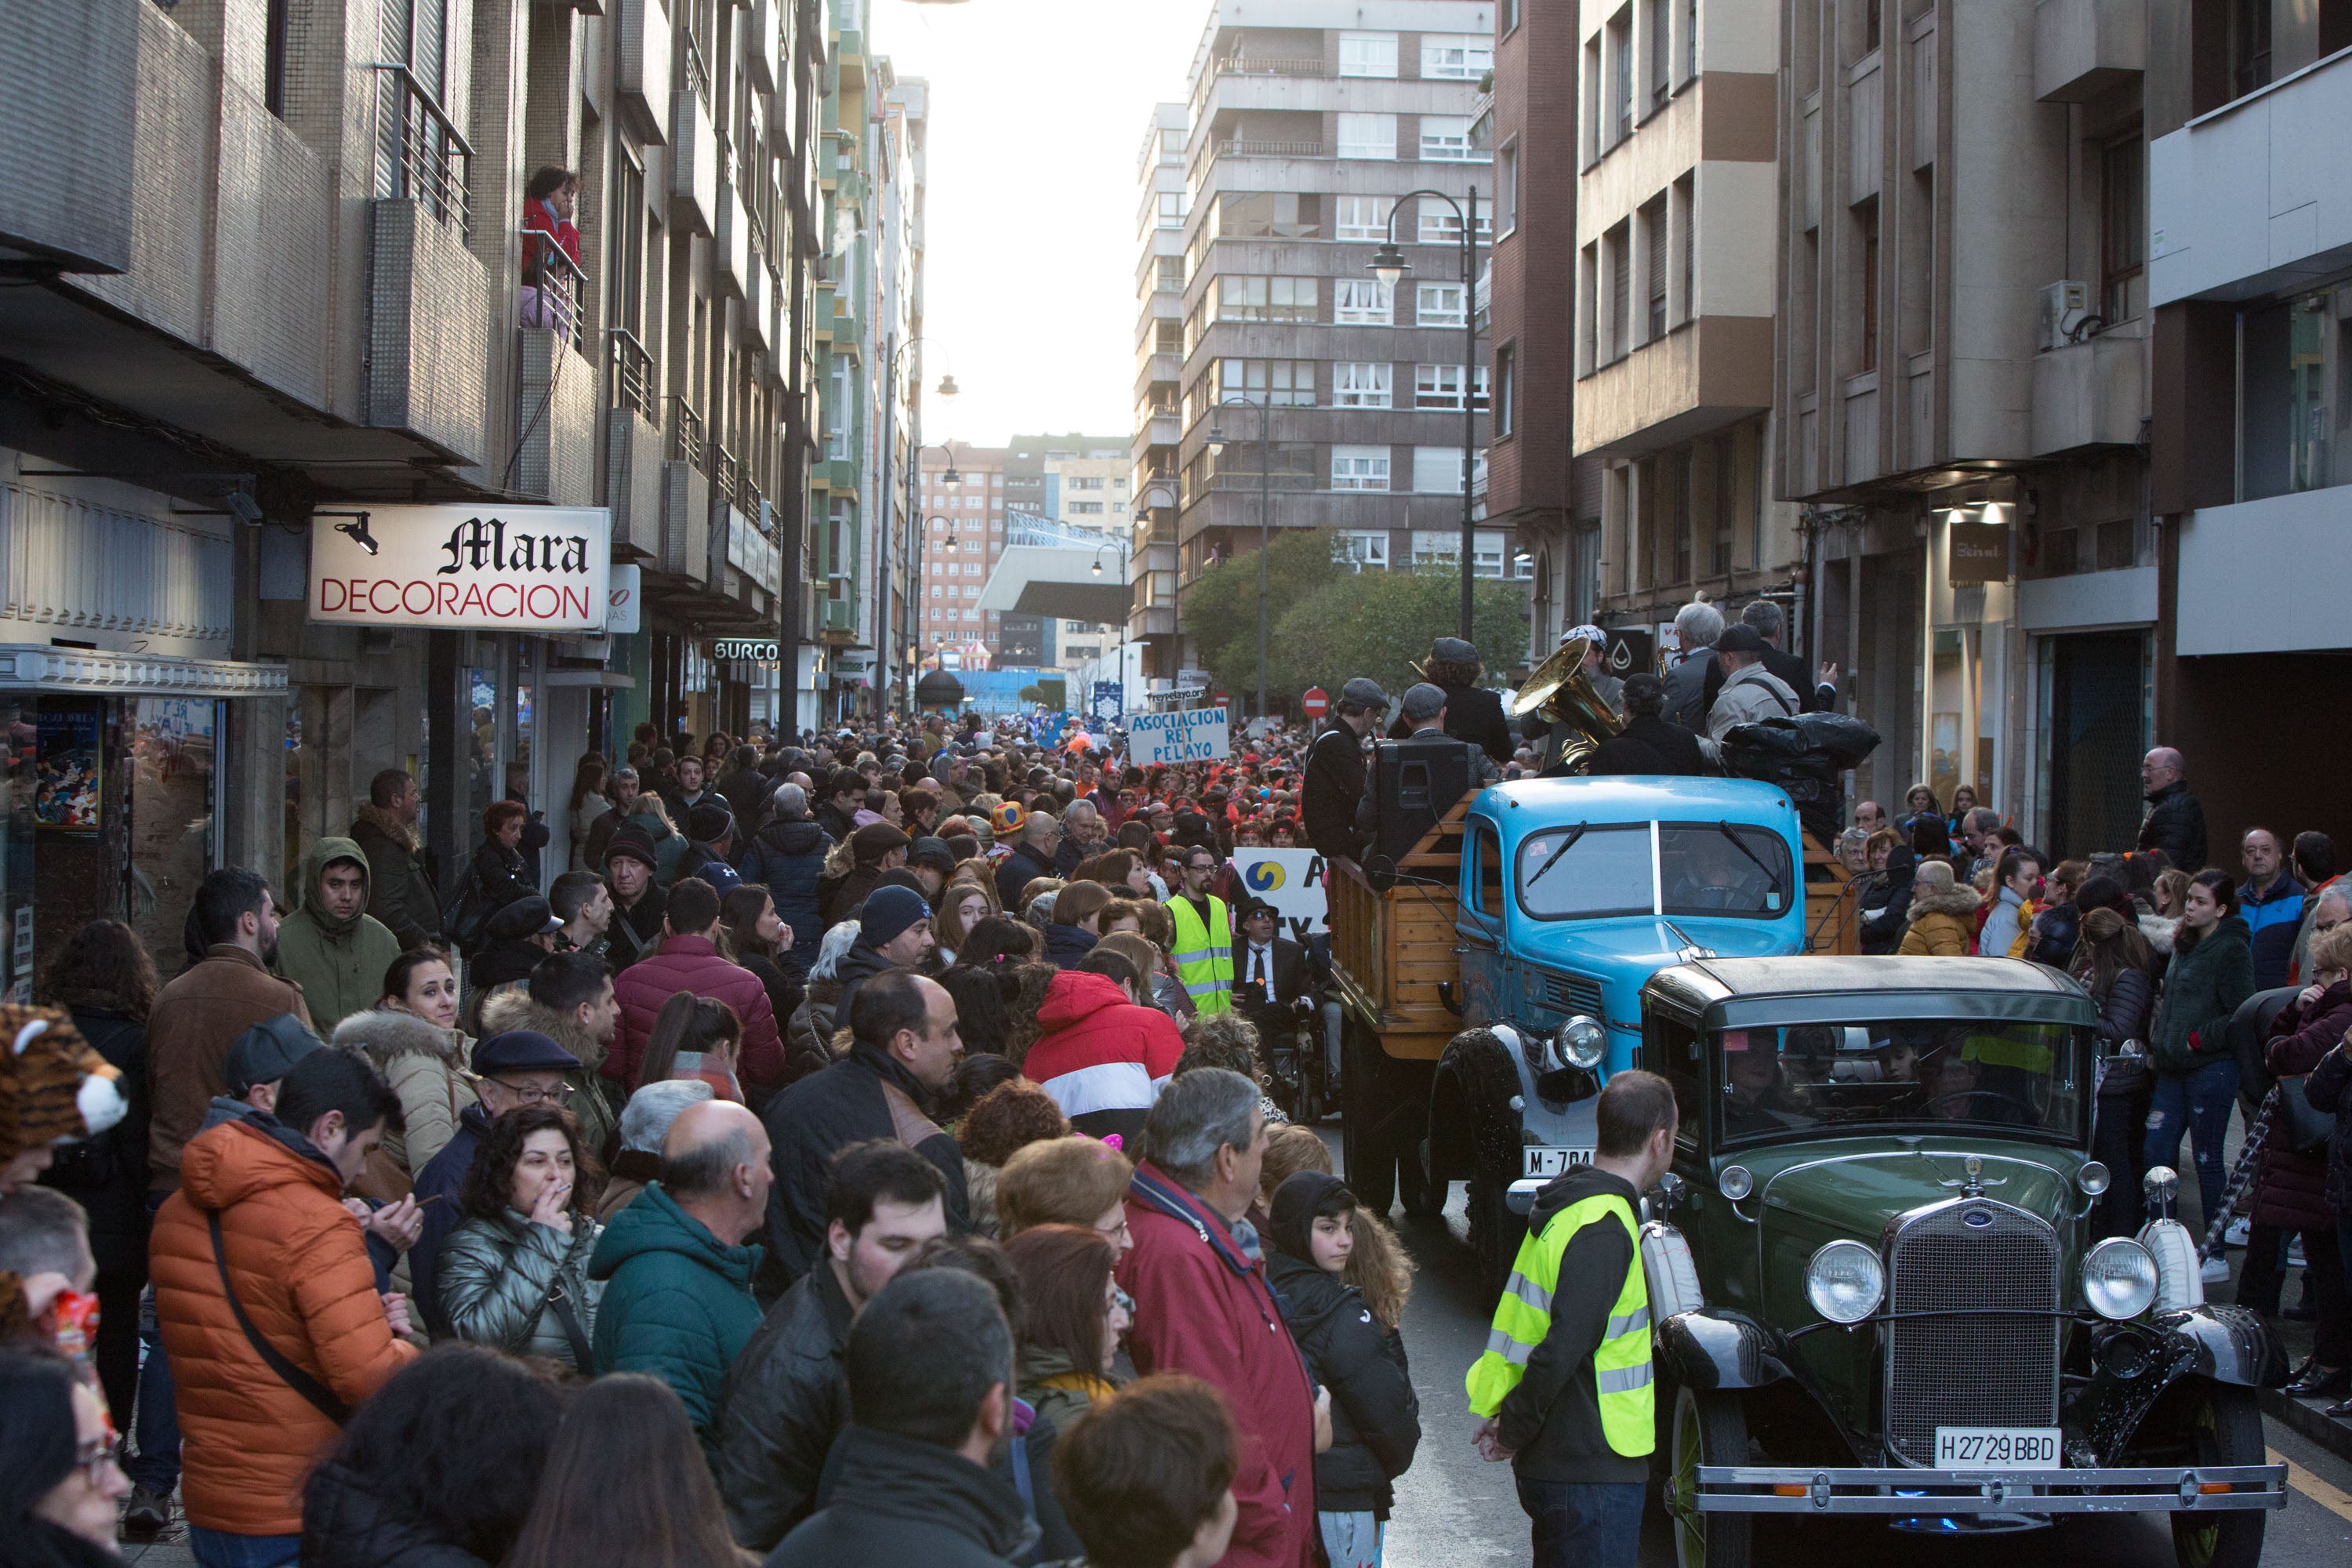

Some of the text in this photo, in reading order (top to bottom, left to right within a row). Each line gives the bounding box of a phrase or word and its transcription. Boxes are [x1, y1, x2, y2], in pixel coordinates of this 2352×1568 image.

[437, 517, 589, 575] Mara
[321, 579, 589, 619] DECORACION
[714, 643, 779, 661] SURCO
[1152, 688, 1205, 702] reypelayo.org
[1131, 709, 1225, 731] ASOCIACIÓN
[1165, 727, 1192, 744] REY
[1153, 742, 1213, 760] PELAYO
